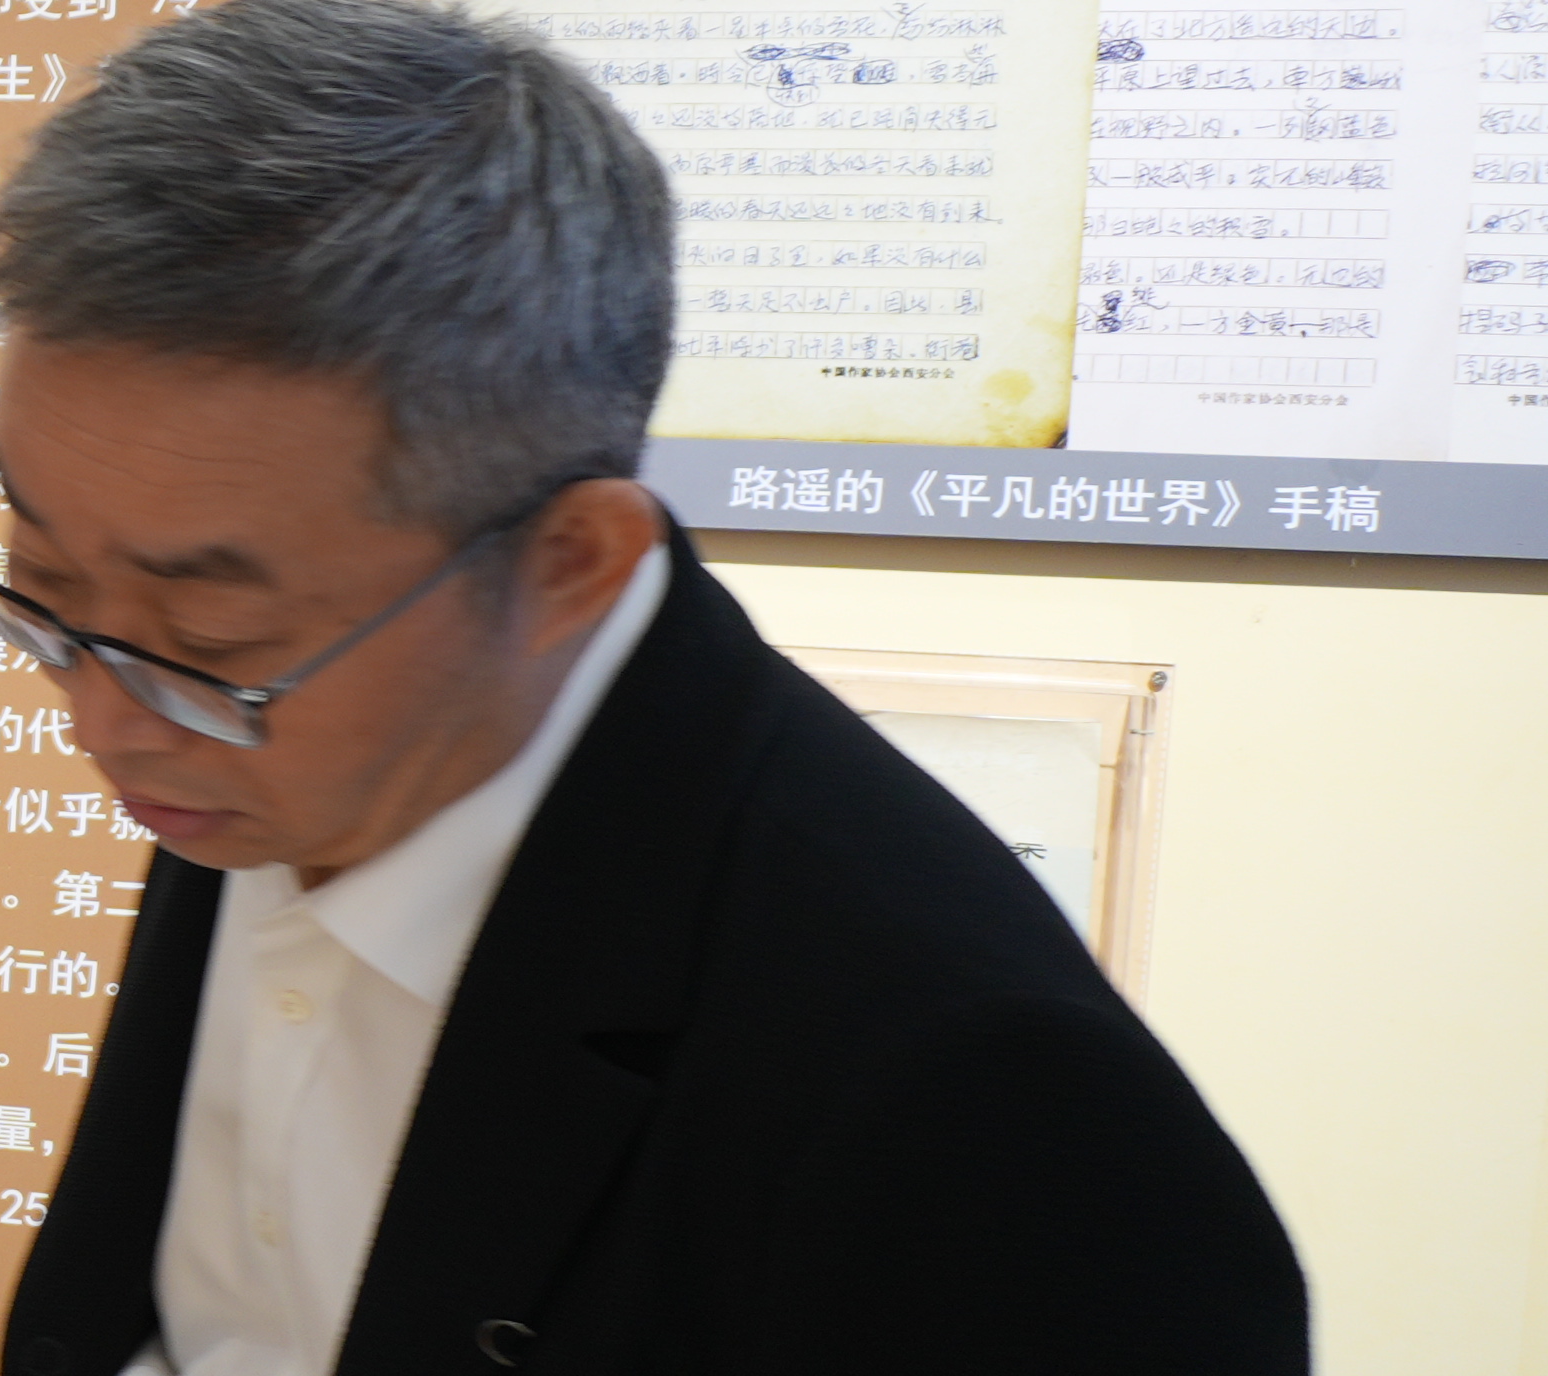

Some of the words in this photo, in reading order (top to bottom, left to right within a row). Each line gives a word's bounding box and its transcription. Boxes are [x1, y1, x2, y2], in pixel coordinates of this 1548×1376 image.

[1196, 390, 1350, 408] 中国作家协会西安分会
[728, 465, 1384, 535] 路遥的《平凡的世界》手稿
